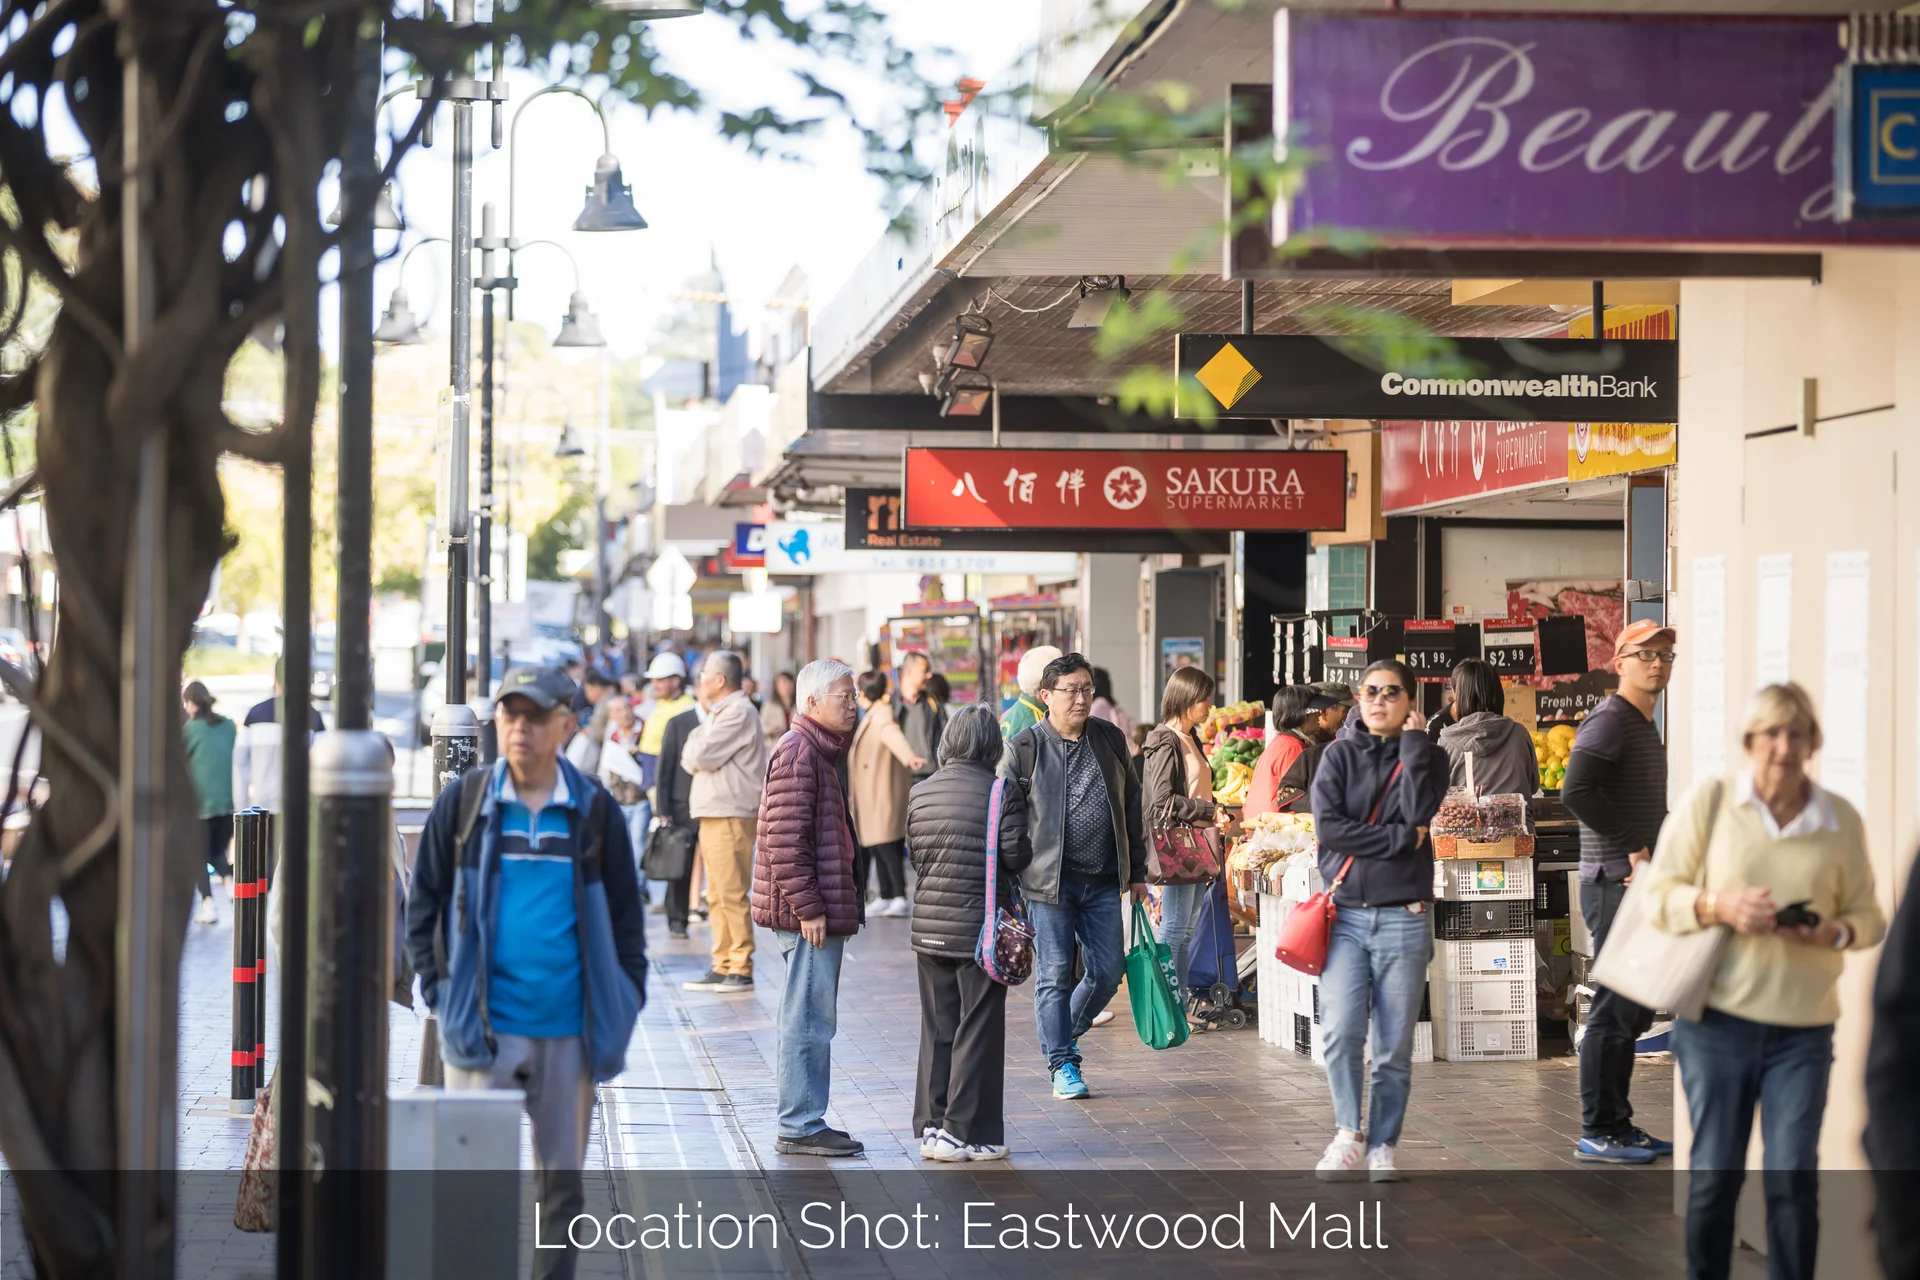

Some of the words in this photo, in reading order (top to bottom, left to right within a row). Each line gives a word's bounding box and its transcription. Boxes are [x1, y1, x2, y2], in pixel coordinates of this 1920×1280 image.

[1346, 36, 1848, 222] Beaut
[1381, 372, 1658, 398] CommonwealthBank
[1495, 430, 1548, 474] SUPERMARKET
[951, 467, 1086, 507] 八佰伴
[1165, 467, 1305, 495] SAKURA
[1165, 495, 1304, 510] SUPERMARKET
[867, 533, 897, 547] Real
[899, 533, 942, 547] Estate
[1410, 651, 1445, 668] $1.99
[1489, 649, 1524, 667] $2.99
[1330, 669, 1360, 685] $2.49
[1541, 696, 1572, 708] Fresh
[1575, 694, 1584, 706] &
